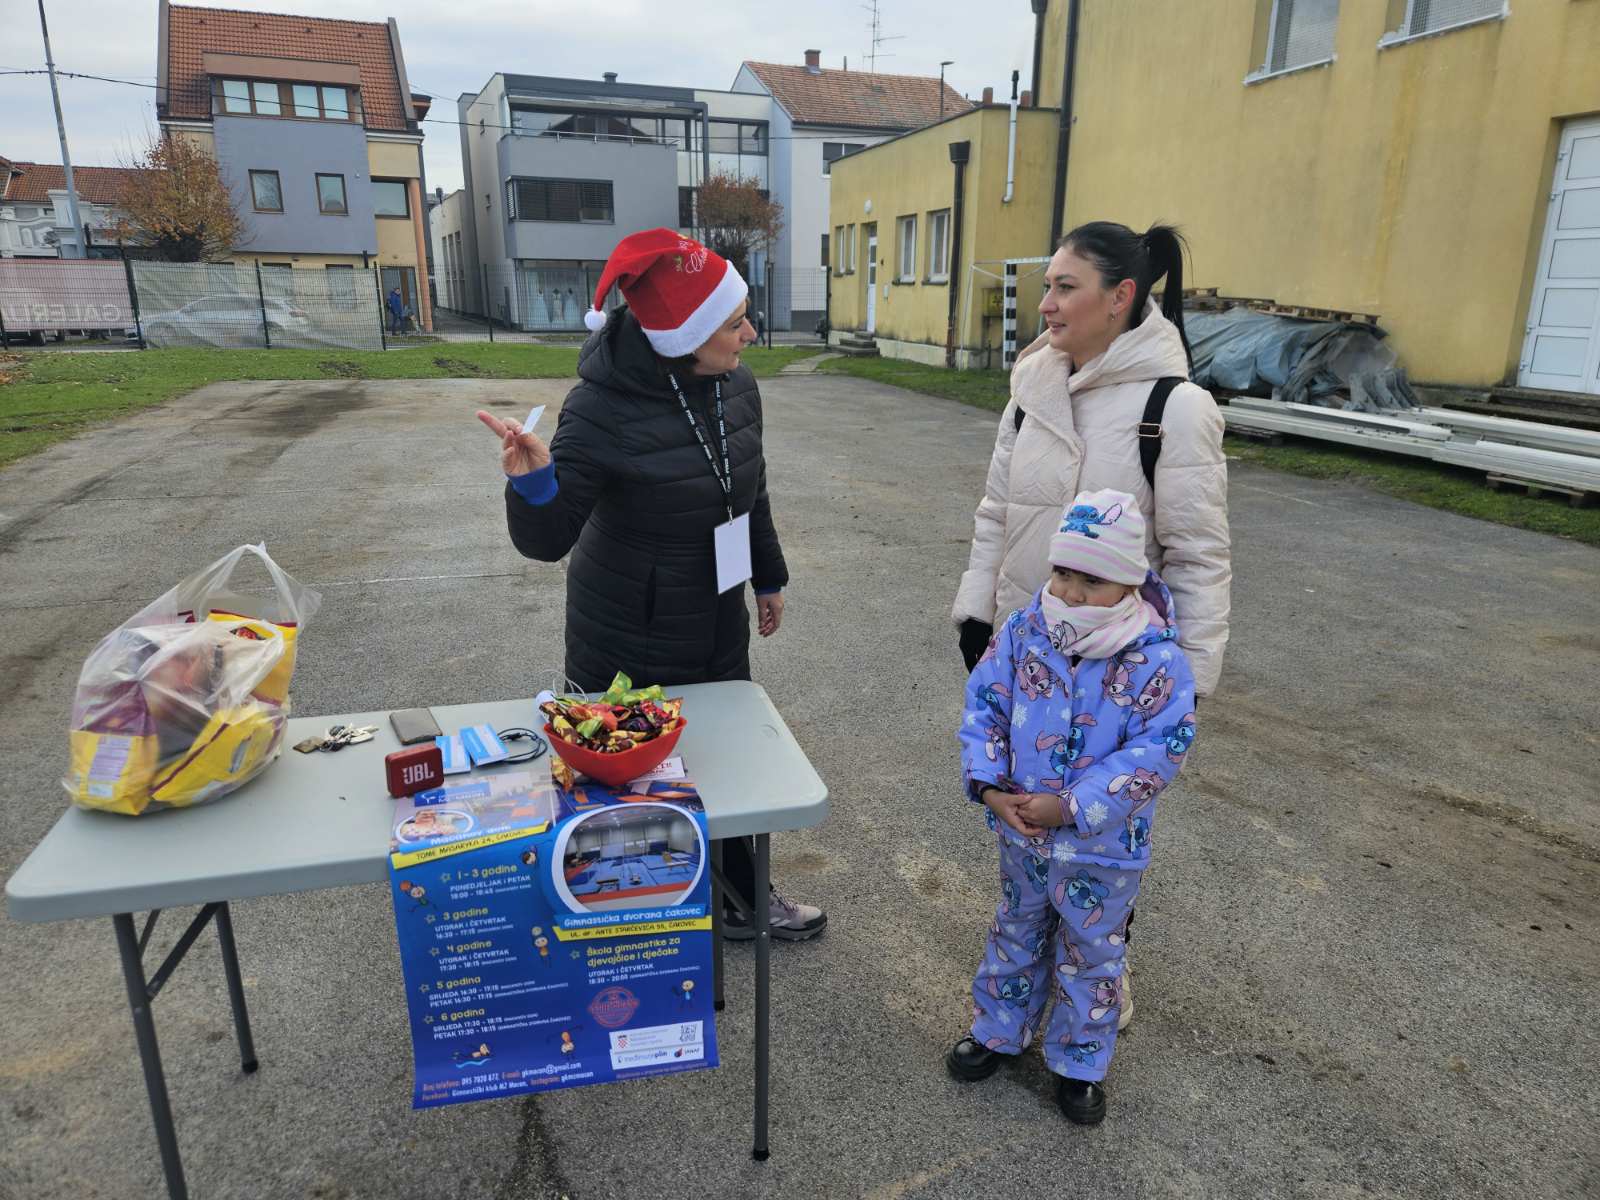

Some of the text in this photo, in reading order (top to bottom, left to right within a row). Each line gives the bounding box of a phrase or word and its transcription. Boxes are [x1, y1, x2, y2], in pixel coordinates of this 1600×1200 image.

[403, 762, 434, 784] JBL
[472, 869, 479, 877] 3
[481, 864, 517, 878] godine
[450, 880, 502, 892] PONEDJELJAK
[508, 874, 531, 884] PETAK
[443, 907, 488, 921] 3 godine
[435, 920, 464, 932] UTORAK
[469, 916, 507, 927] ČETVRTAK
[457, 940, 492, 953] godine
[587, 945, 612, 957] Škola
[615, 939, 666, 953] gimnastike
[439, 955, 468, 965] UTORAK
[473, 949, 509, 959] ČETVRTAK
[587, 952, 636, 968] djevojčice
[642, 947, 678, 960] dječake
[589, 969, 615, 977] UTORAK
[620, 963, 654, 974] ČETVRTAK
[437, 981, 443, 990] 5
[446, 976, 481, 990] godina
[429, 992, 459, 1001] SRIJEDA
[430, 1000, 452, 1008] PETAK
[441, 1007, 485, 1021] 6 godina
[433, 1023, 462, 1033] SRIJEDA
[434, 1032, 456, 1040] PETAK
